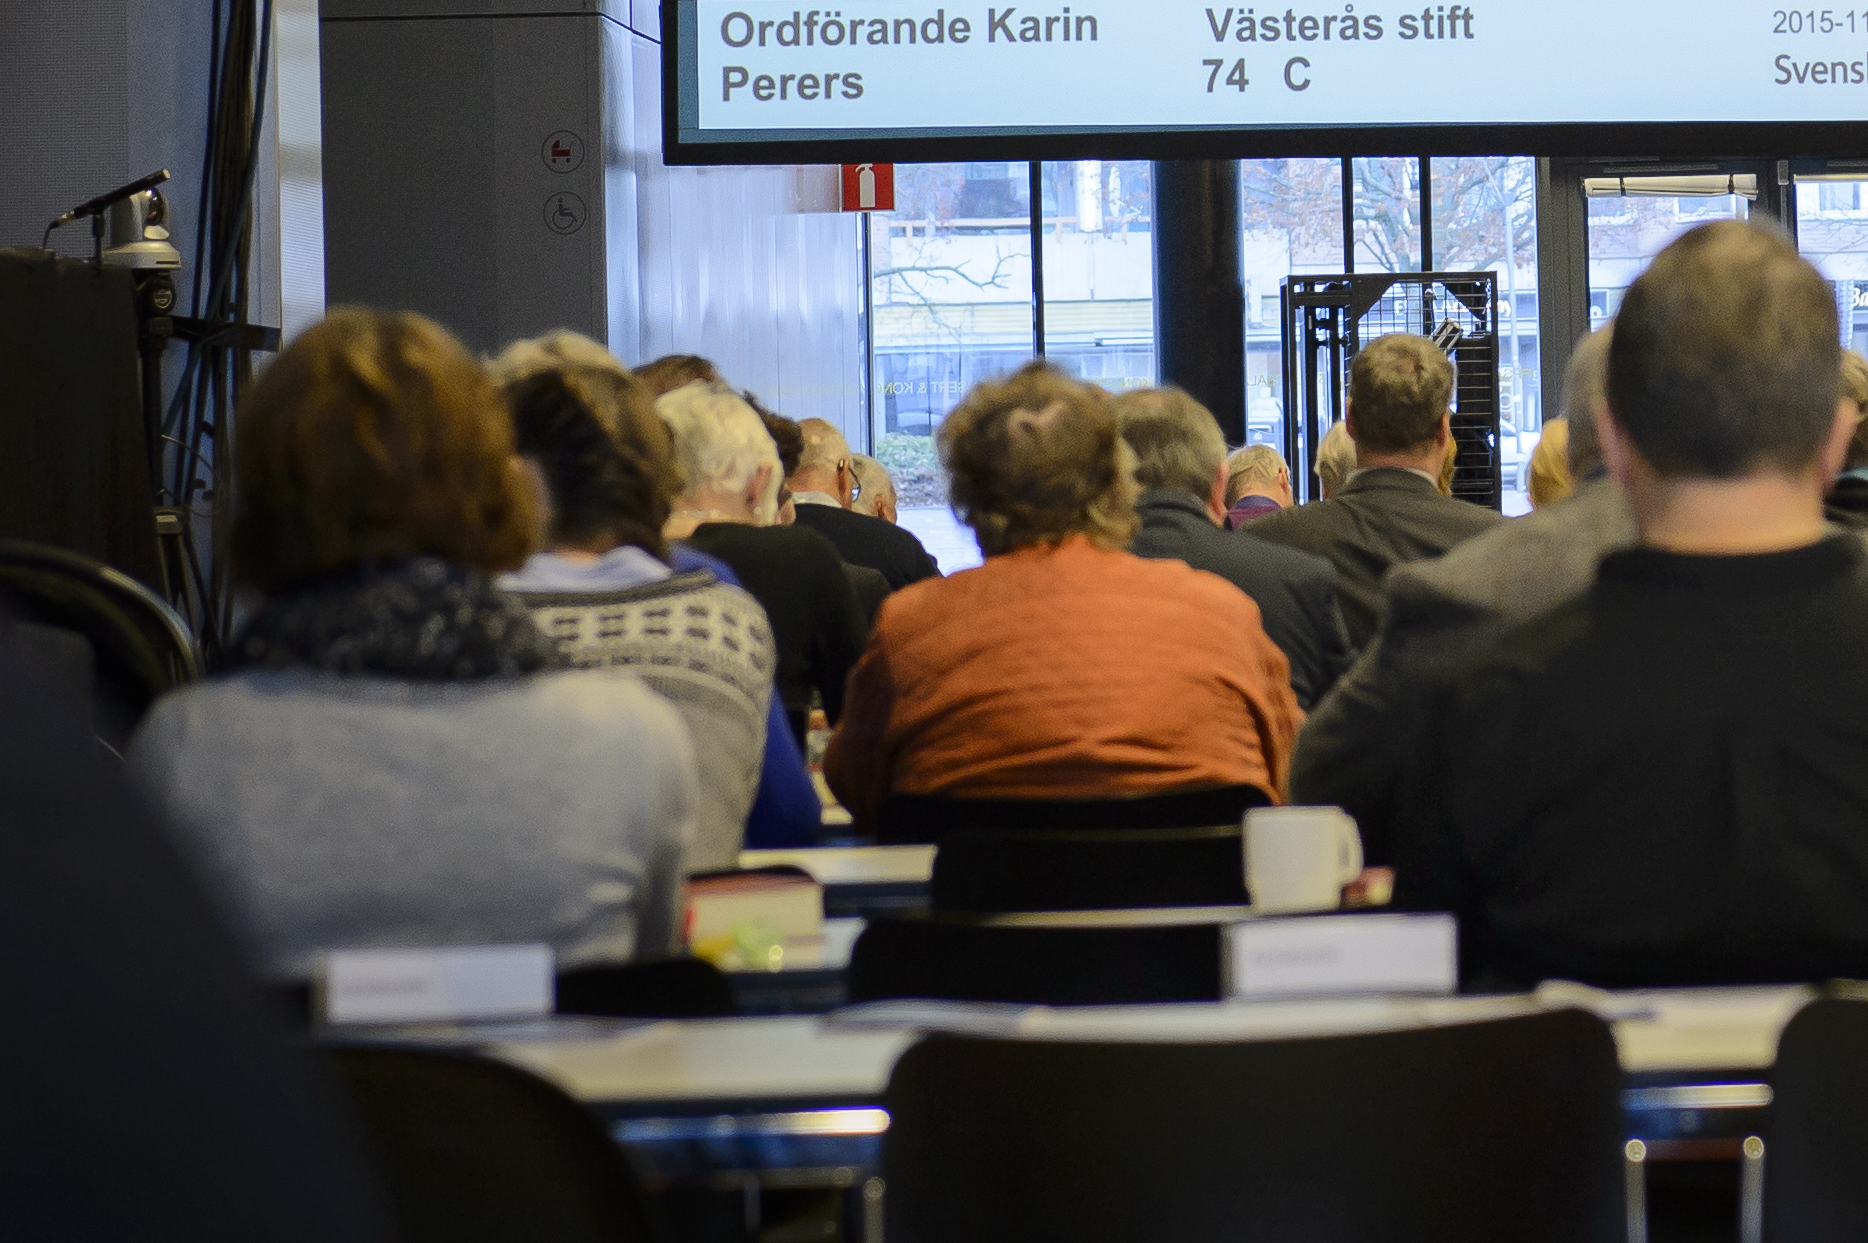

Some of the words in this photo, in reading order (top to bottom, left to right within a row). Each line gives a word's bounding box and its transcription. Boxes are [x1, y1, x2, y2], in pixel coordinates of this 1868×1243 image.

[720, 8, 971, 49] Ordförande
[988, 6, 1099, 44] Karin
[1204, 3, 1384, 44] Västerås
[1397, 4, 1475, 41] stift
[721, 65, 865, 102] Perers
[1201, 57, 1250, 94] 74
[1283, 55, 1312, 93] C
